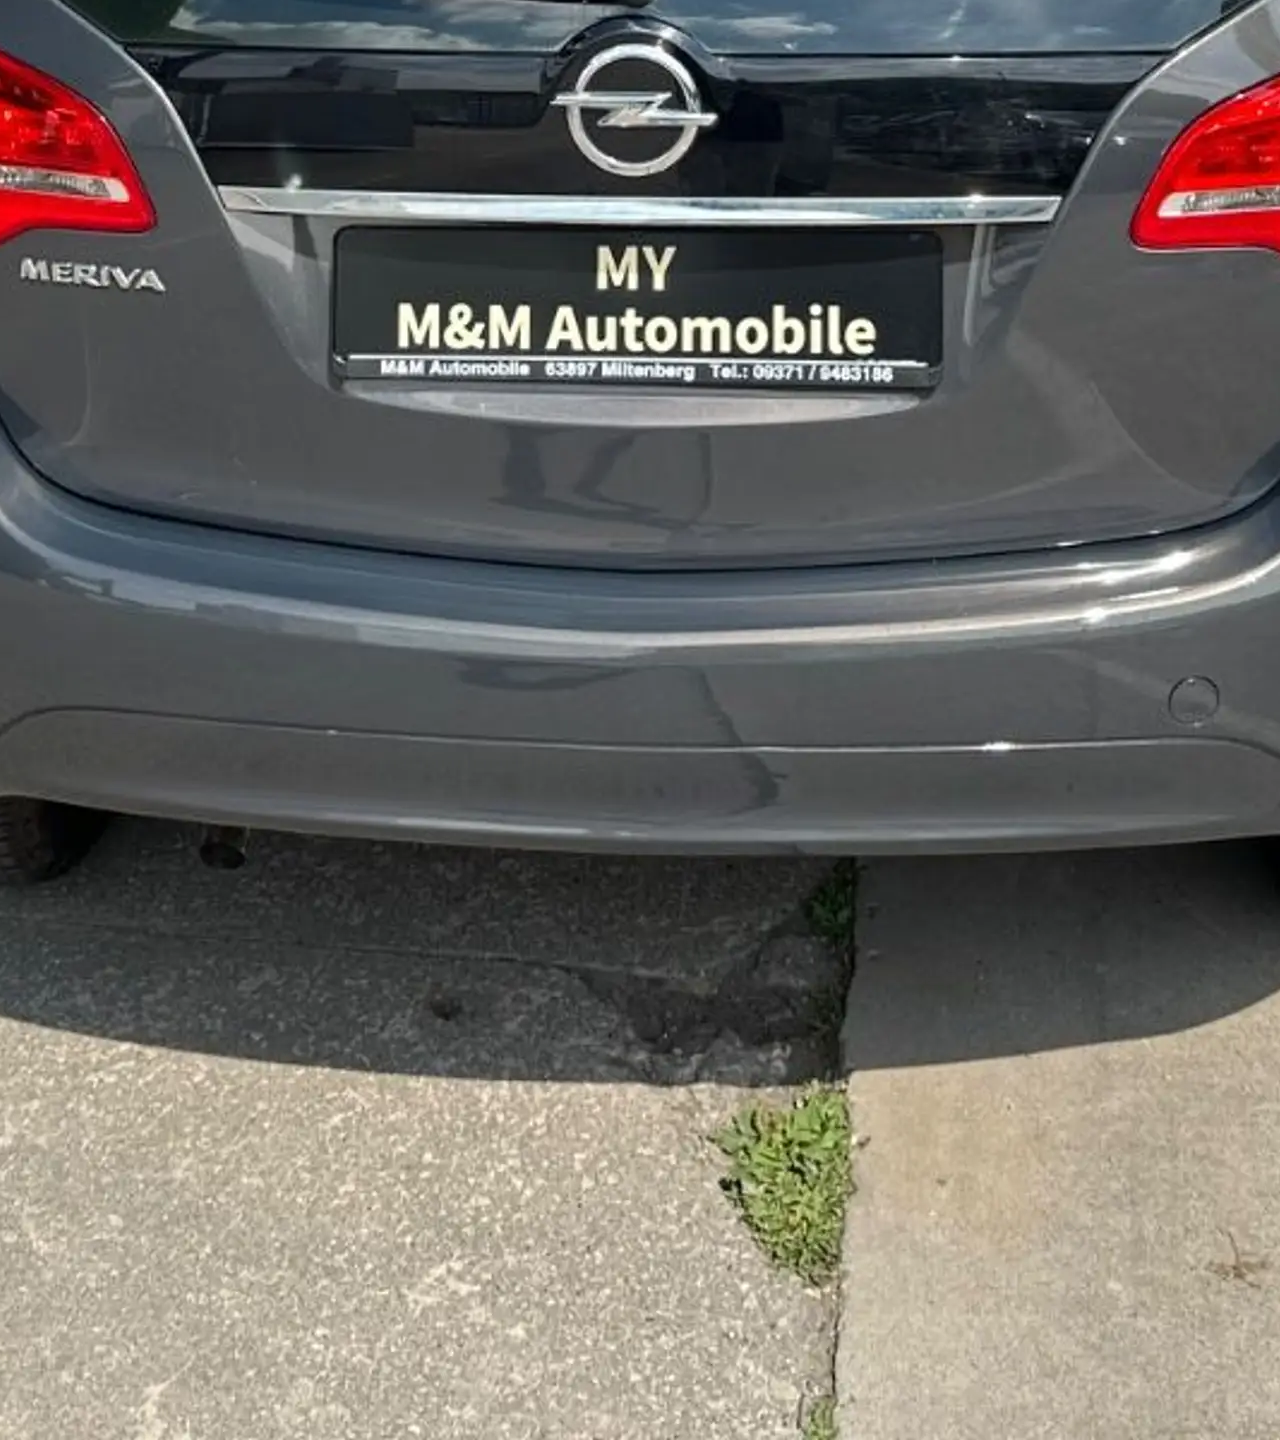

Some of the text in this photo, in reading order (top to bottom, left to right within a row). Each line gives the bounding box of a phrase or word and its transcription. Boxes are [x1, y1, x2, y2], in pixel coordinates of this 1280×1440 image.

[19, 257, 167, 292] MERIVA
[596, 245, 677, 292] MY
[396, 303, 877, 356] M&M Automobile
[380, 360, 425, 376] M&M
[429, 359, 531, 377] Automobile
[545, 361, 597, 377] 63897
[601, 362, 696, 383] Miltenberg
